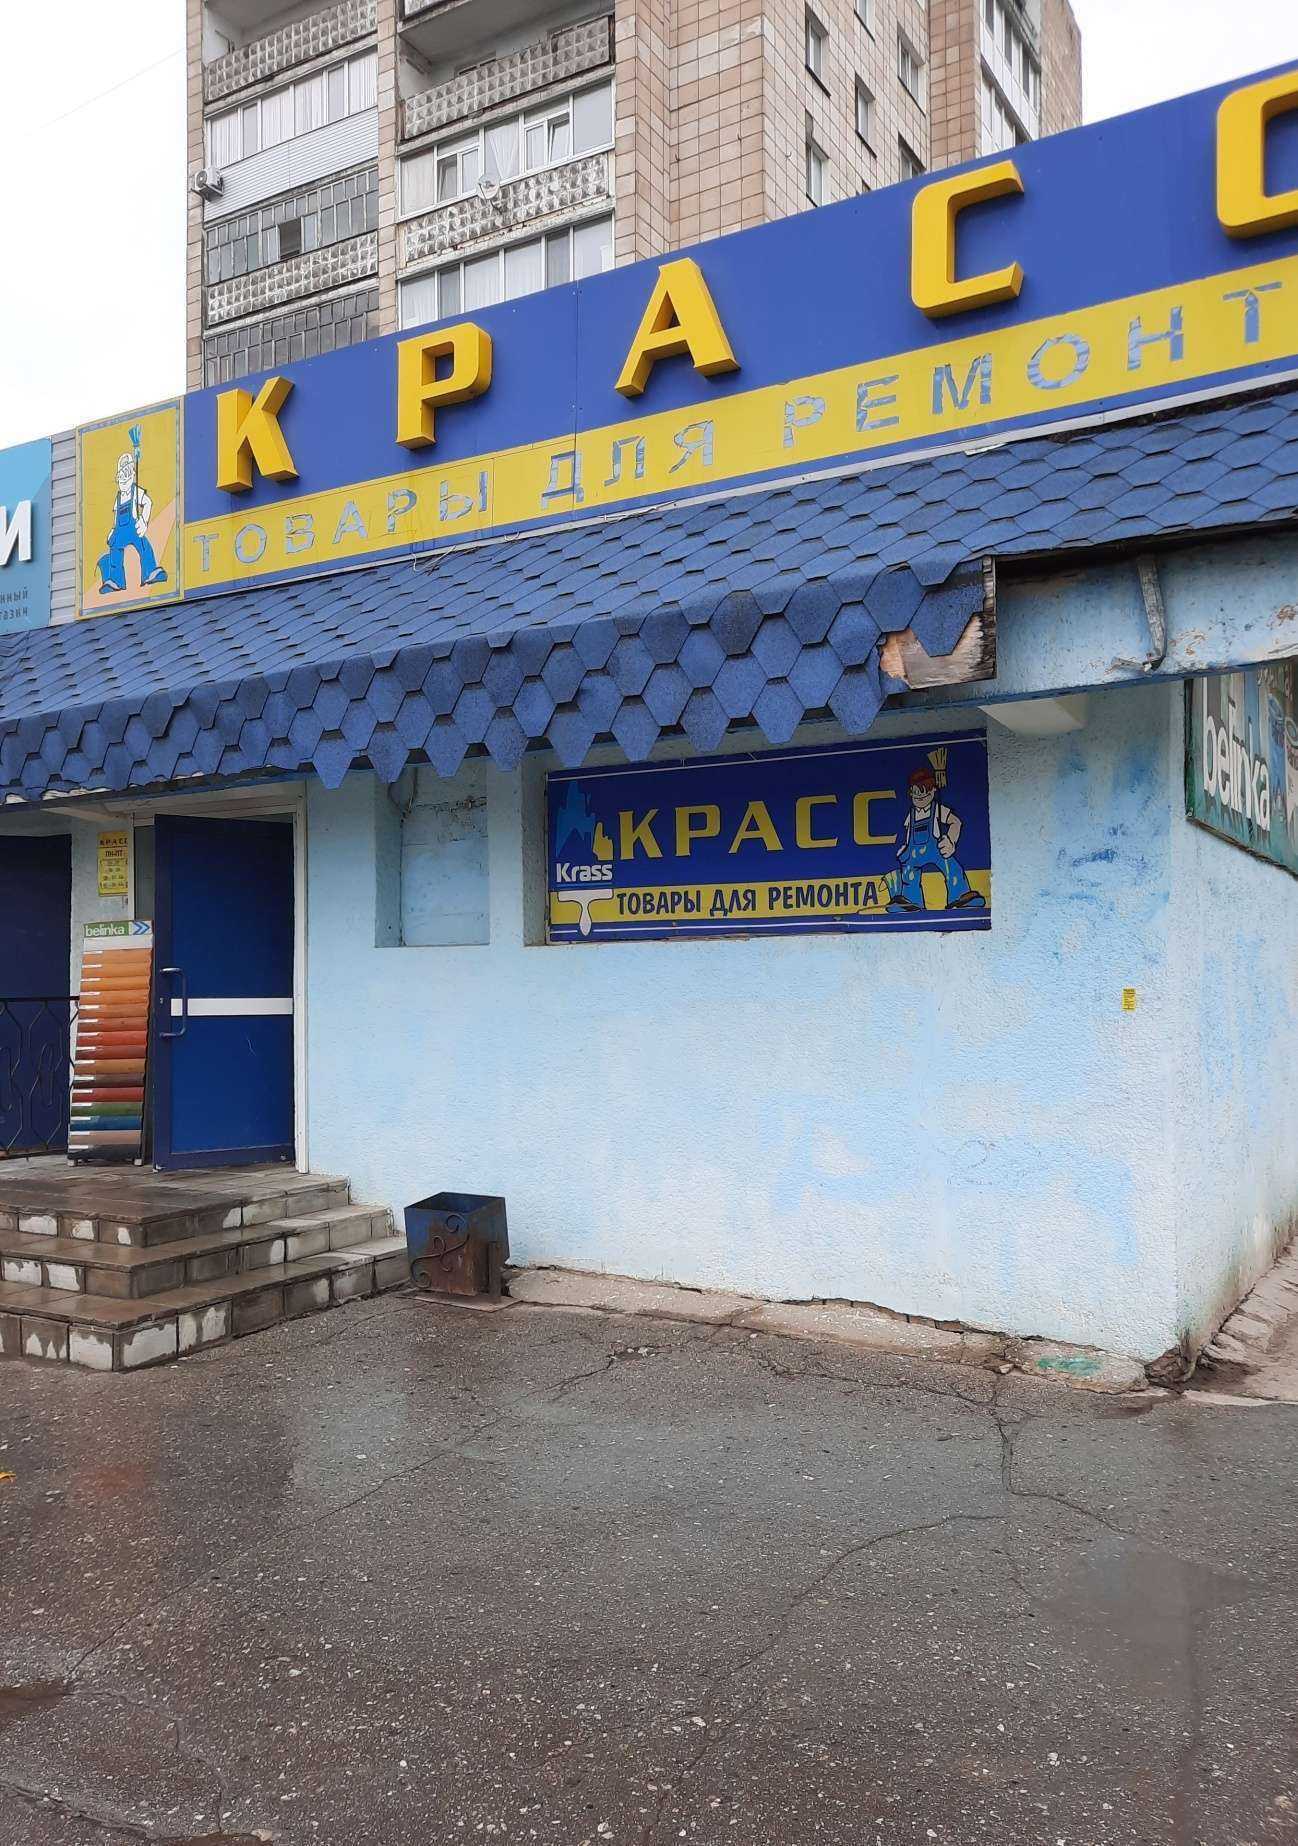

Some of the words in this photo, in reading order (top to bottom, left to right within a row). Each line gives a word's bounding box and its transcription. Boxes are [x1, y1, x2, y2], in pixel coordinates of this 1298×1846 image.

[215, 68, 1298, 494] КРАСС
[193, 469, 488, 573] ТОВАРЫ
[540, 418, 714, 510] ДЛЯ
[782, 281, 1282, 449] РЕМОНТ
[1203, 676, 1270, 832] belinka
[618, 789, 898, 861] КРАСС
[555, 862, 613, 883] Krass
[616, 890, 701, 915] ТОВАРЫ
[709, 888, 757, 917] ДЛЯ
[768, 881, 879, 911] РЕМОНТА
[85, 923, 125, 937] belinka
